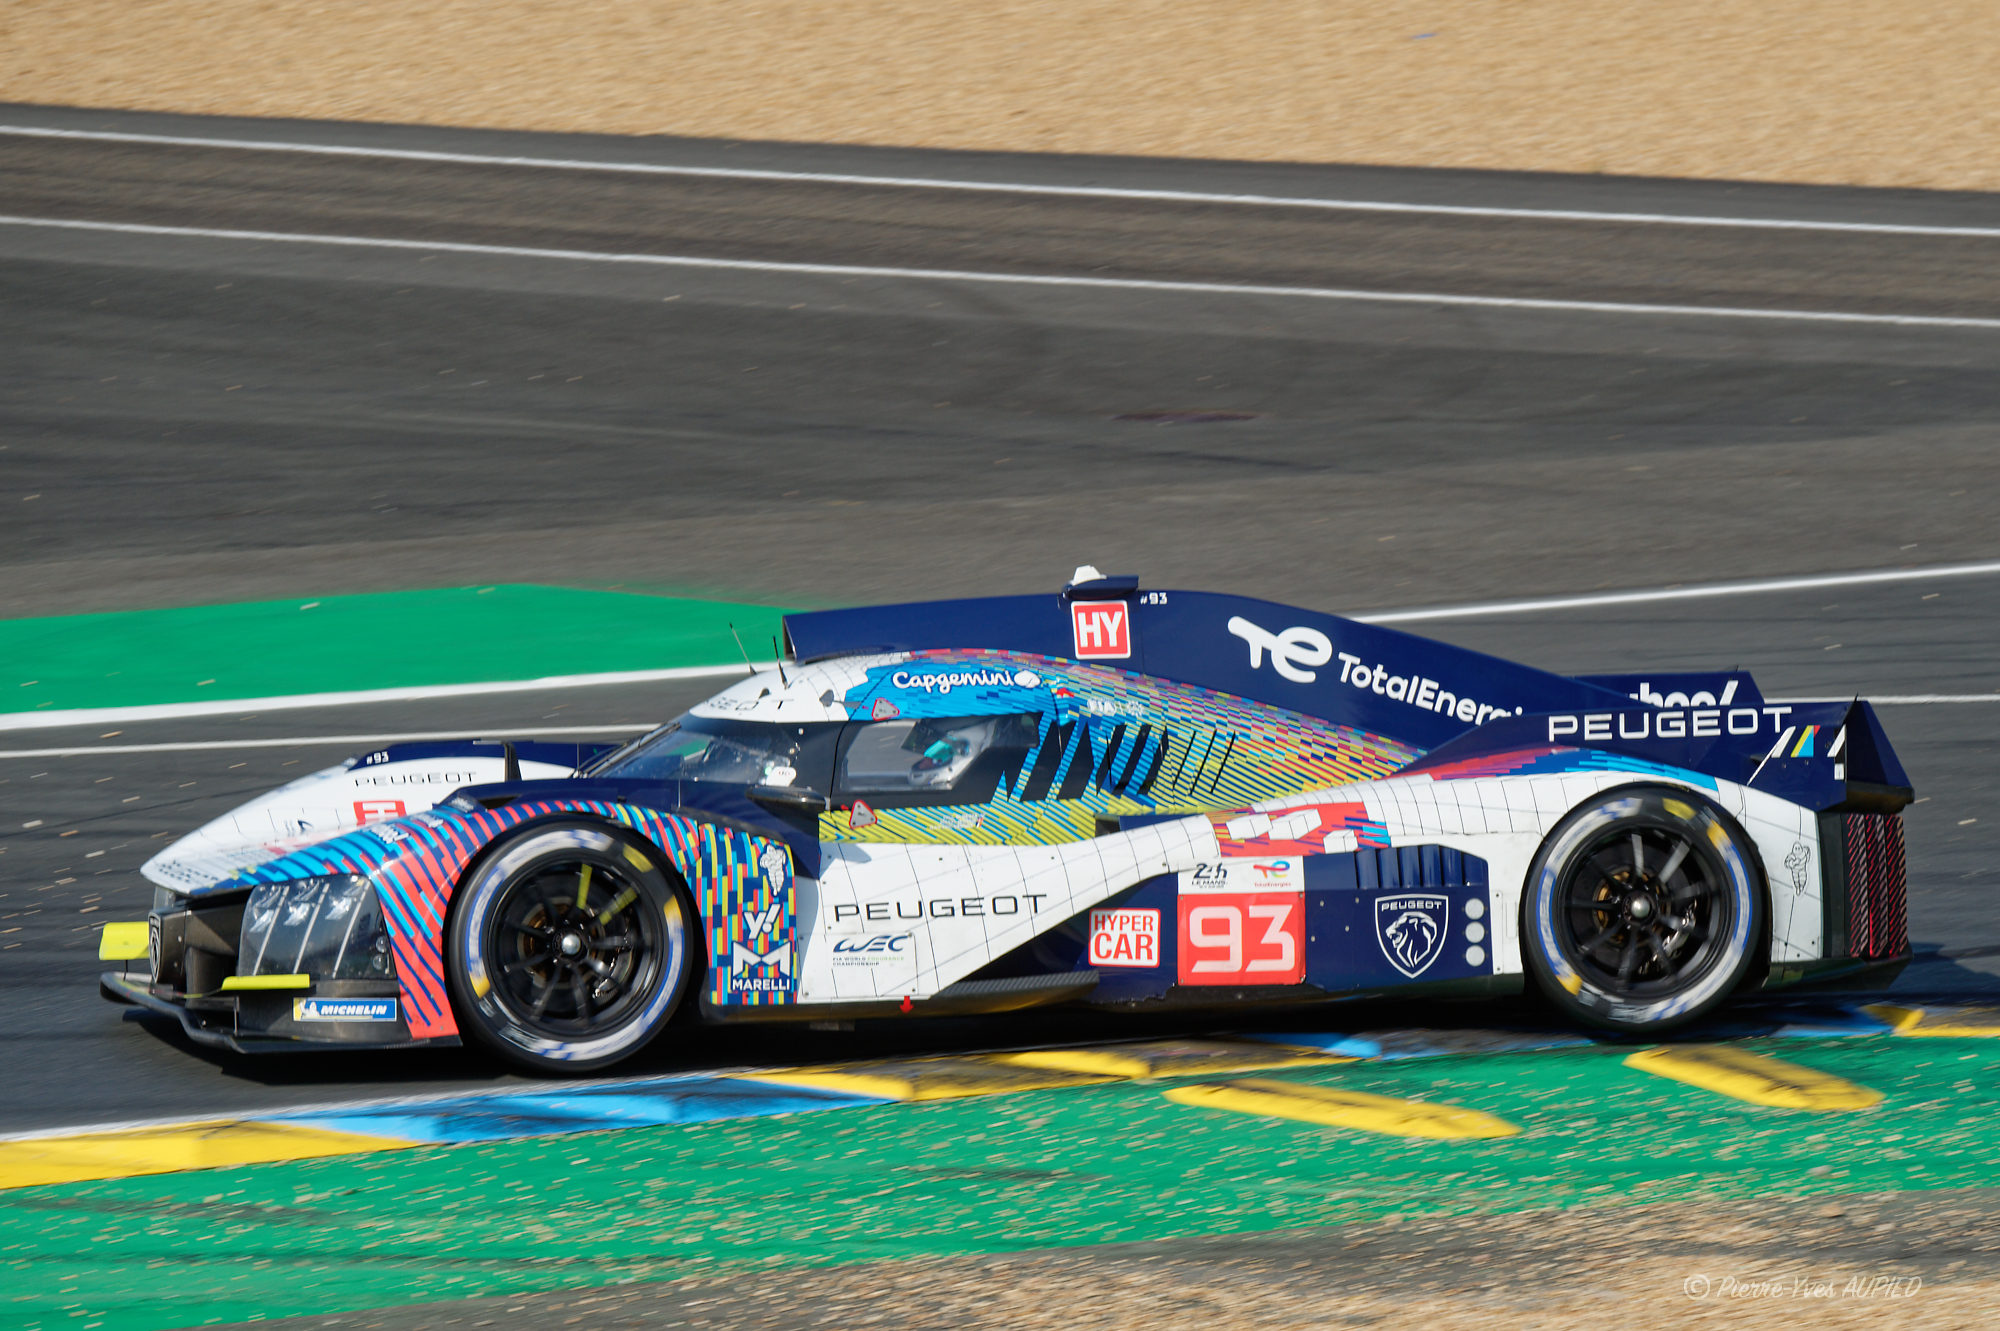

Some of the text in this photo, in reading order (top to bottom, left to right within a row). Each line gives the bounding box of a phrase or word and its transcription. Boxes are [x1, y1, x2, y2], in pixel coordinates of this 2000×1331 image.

[1140, 592, 1168, 605] #93
[1077, 611, 1123, 648] HY
[892, 669, 1015, 694] Capgemini
[1548, 706, 1793, 742] PEUGEOT
[366, 751, 389, 765] #93
[355, 771, 477, 787] PEUGEOT
[834, 894, 1047, 922] PEUGEOT
[1381, 900, 1442, 912] PEUGEOT
[1094, 914, 1154, 932] HYPER
[833, 935, 909, 952] WEC
[1094, 932, 1153, 960] CAR
[1189, 904, 1296, 973] 93
[732, 978, 790, 991] MARELLI
[320, 1005, 388, 1015] MICHELIN
